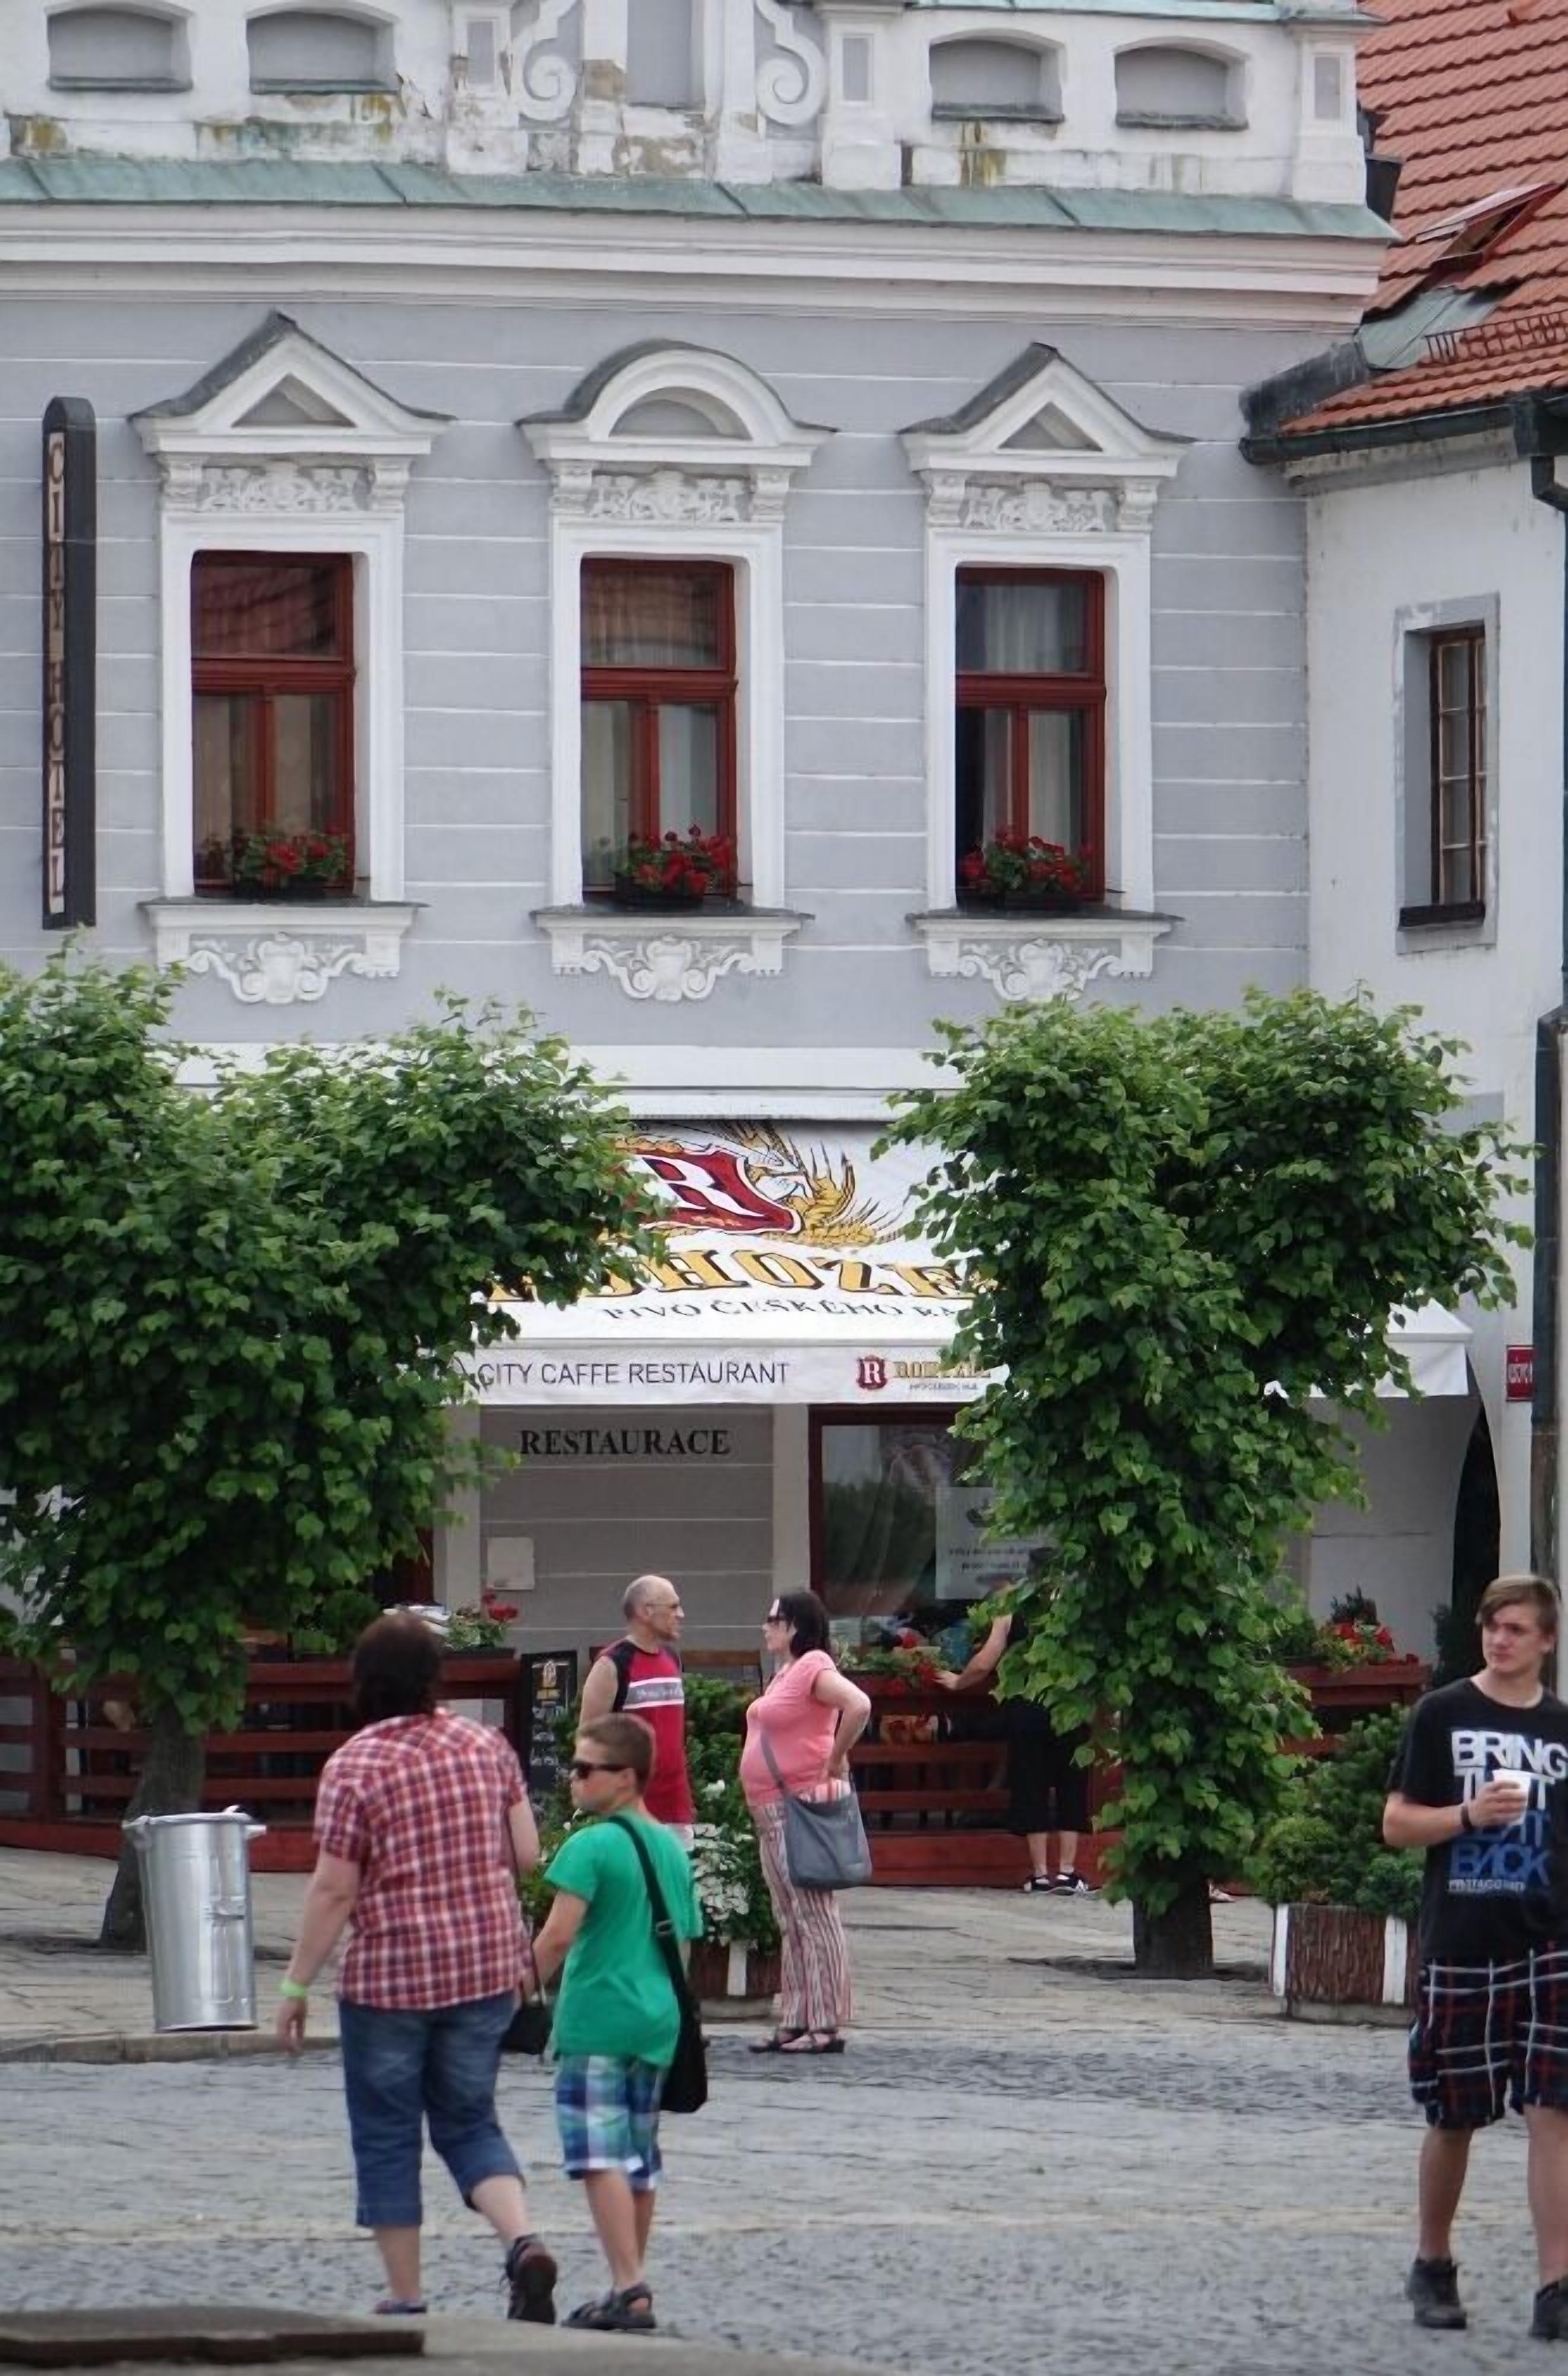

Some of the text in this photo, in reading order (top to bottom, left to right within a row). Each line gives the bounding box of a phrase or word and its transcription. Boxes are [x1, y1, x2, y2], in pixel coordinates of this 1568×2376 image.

[49, 441, 65, 898] CITY HOTEL
[478, 1362, 790, 1385] CITY CAFFE RESTAURANT
[520, 1429, 731, 1455] RESTAURACE
[1452, 1730, 1568, 1778] BRING
[1450, 1843, 1553, 1885] BACK
